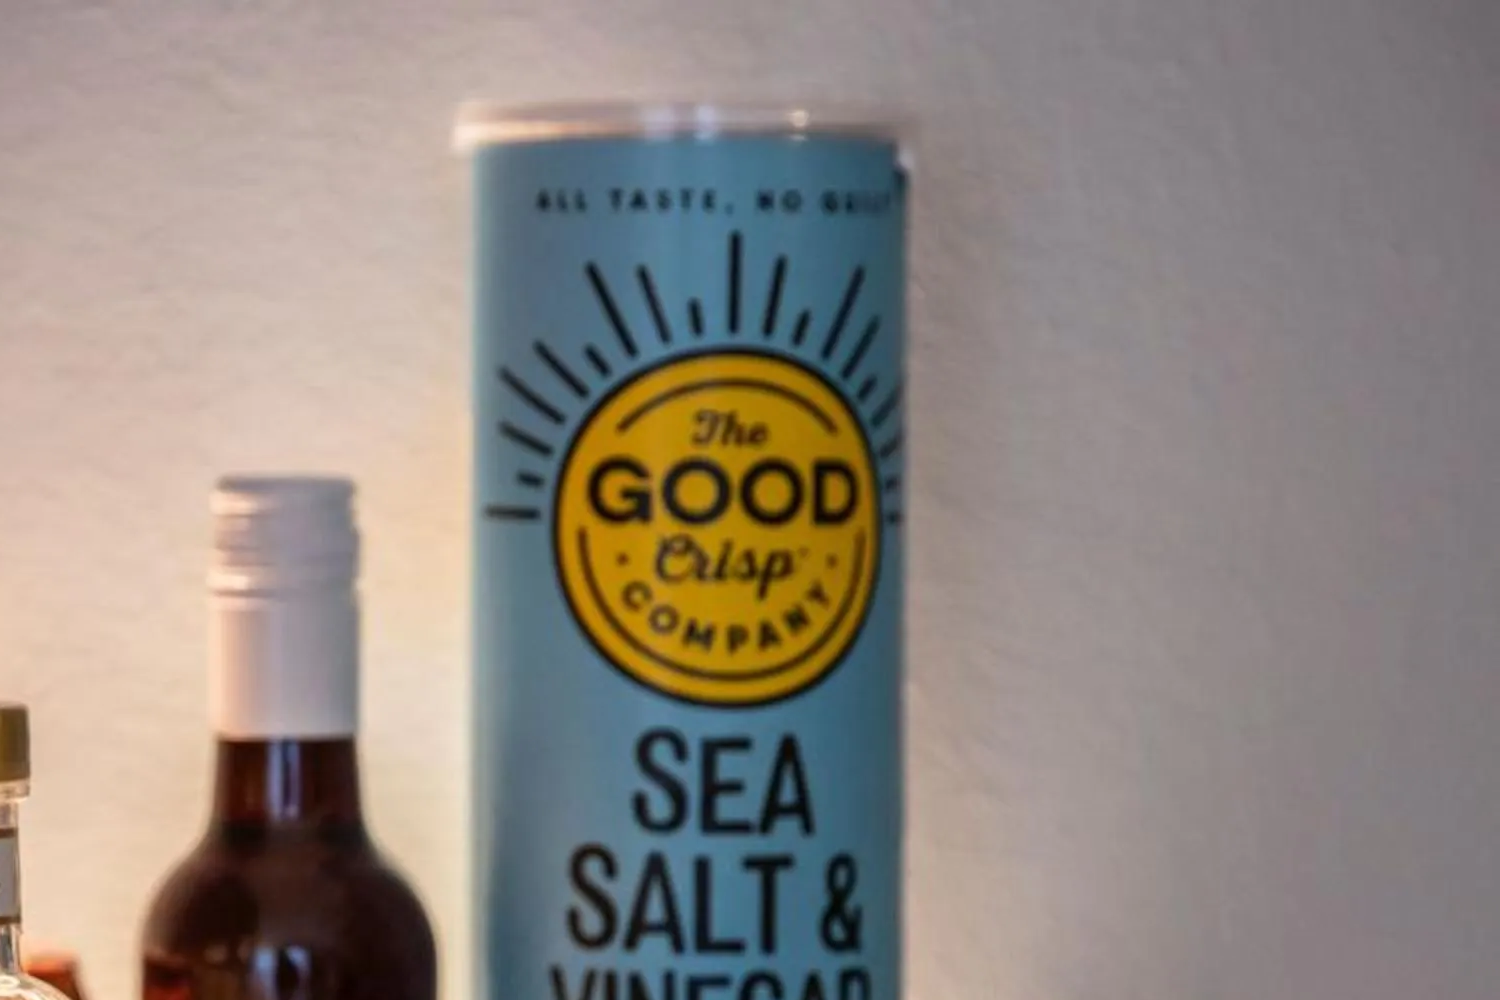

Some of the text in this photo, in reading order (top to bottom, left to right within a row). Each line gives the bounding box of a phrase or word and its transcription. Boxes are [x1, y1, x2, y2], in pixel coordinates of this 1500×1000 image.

[535, 188, 588, 213] ALL
[755, 188, 802, 213] NO
[691, 408, 768, 446] The
[587, 456, 859, 526] GOOD
[655, 535, 795, 600] Crisp
[621, 582, 831, 653] COMPANY
[632, 726, 815, 836] SEA
[565, 842, 863, 955] SALT &
